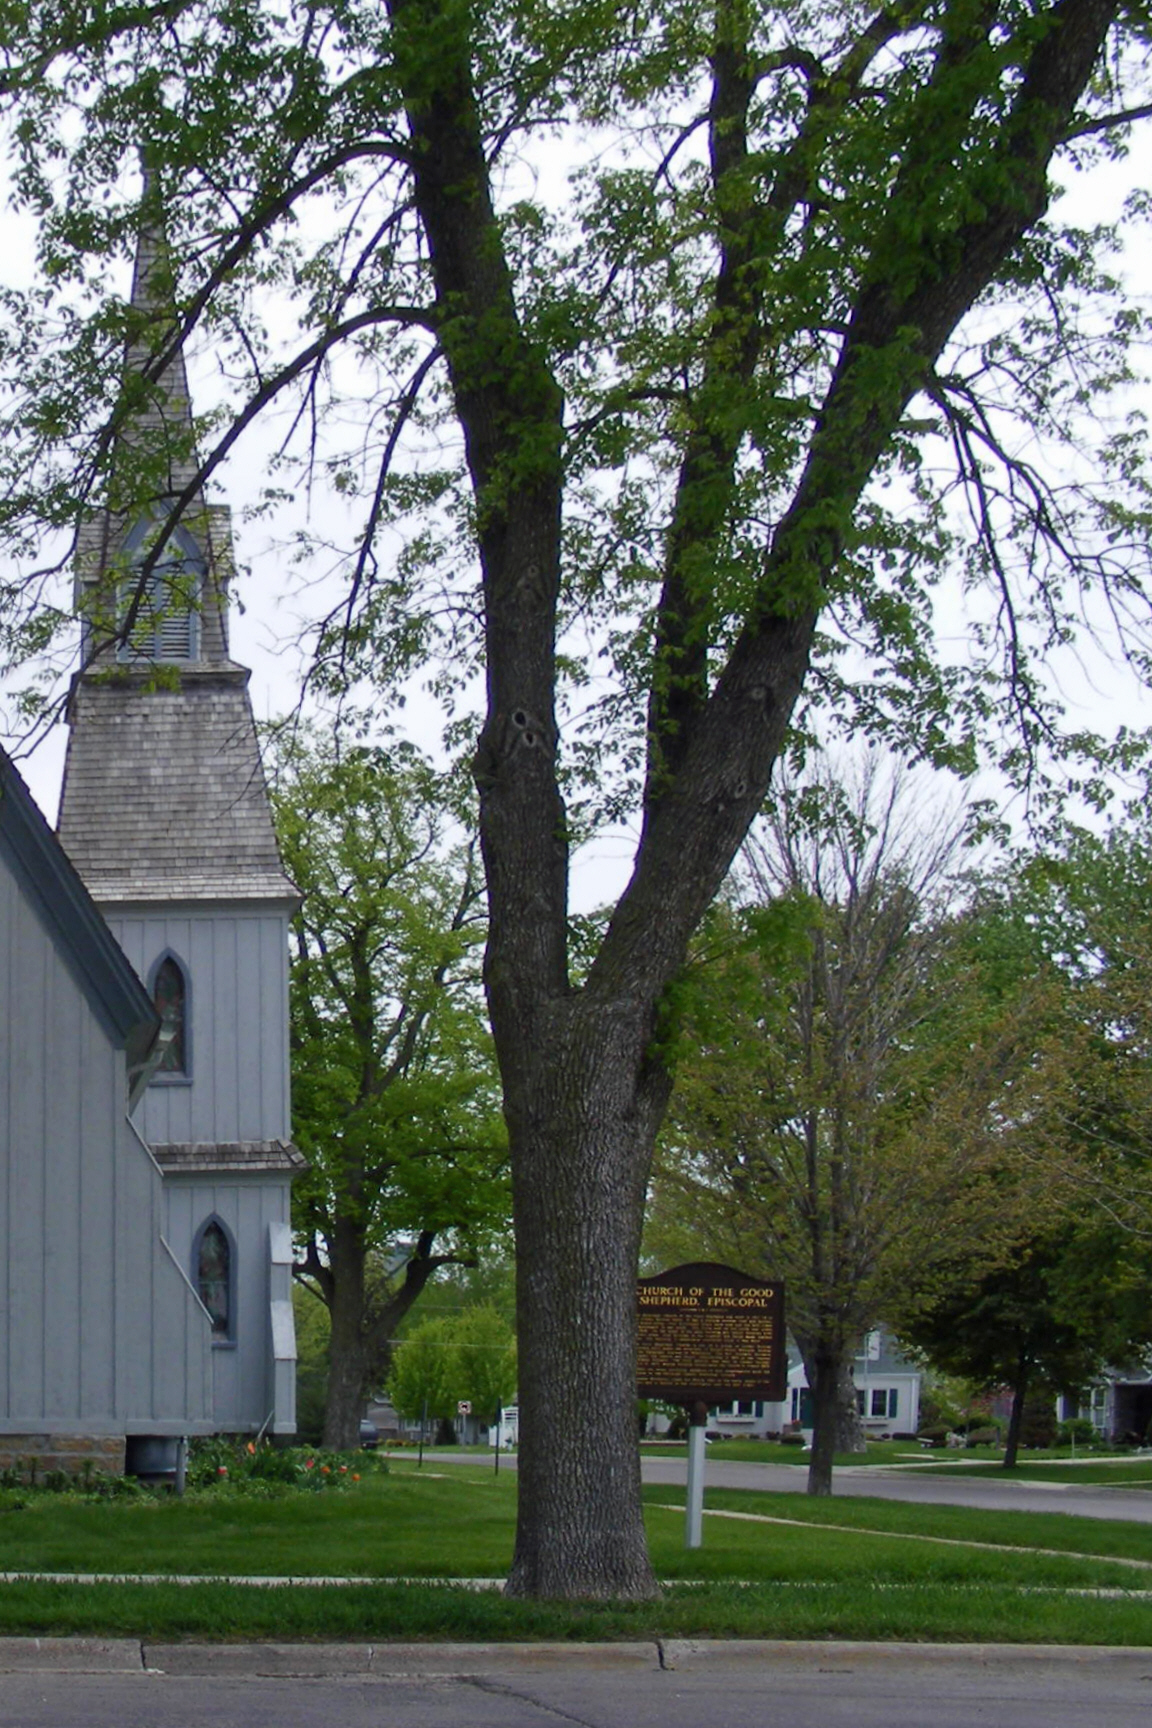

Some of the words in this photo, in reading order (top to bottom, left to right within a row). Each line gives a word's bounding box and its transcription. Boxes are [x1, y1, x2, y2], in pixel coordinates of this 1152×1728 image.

[636, 1286, 683, 1296] CHURCH
[689, 1287, 704, 1296] OF
[712, 1287, 733, 1297] THE
[740, 1288, 774, 1298] GOOD
[707, 1297, 768, 1307] EPISCOPAL
